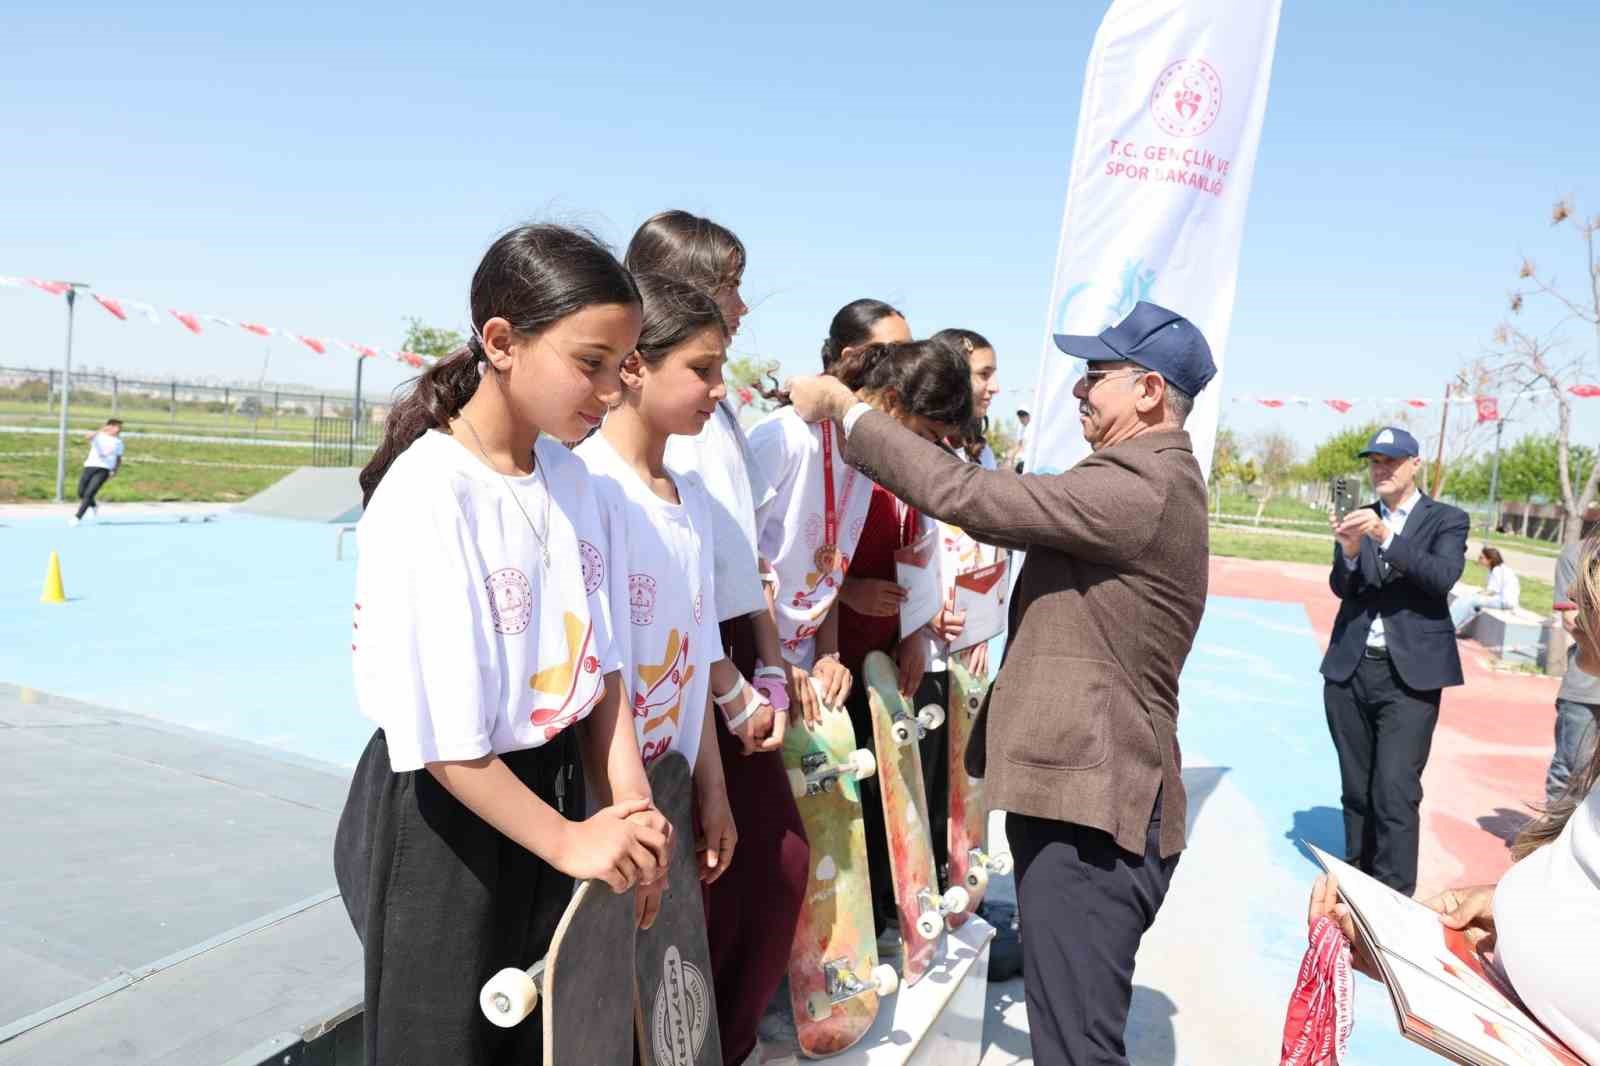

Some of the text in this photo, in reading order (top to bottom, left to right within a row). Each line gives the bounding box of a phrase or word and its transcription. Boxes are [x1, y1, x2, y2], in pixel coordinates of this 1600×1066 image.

[1104, 160, 1149, 180] SPOR
[1109, 139, 1137, 158] T.C.
[1217, 158, 1230, 176] VE
